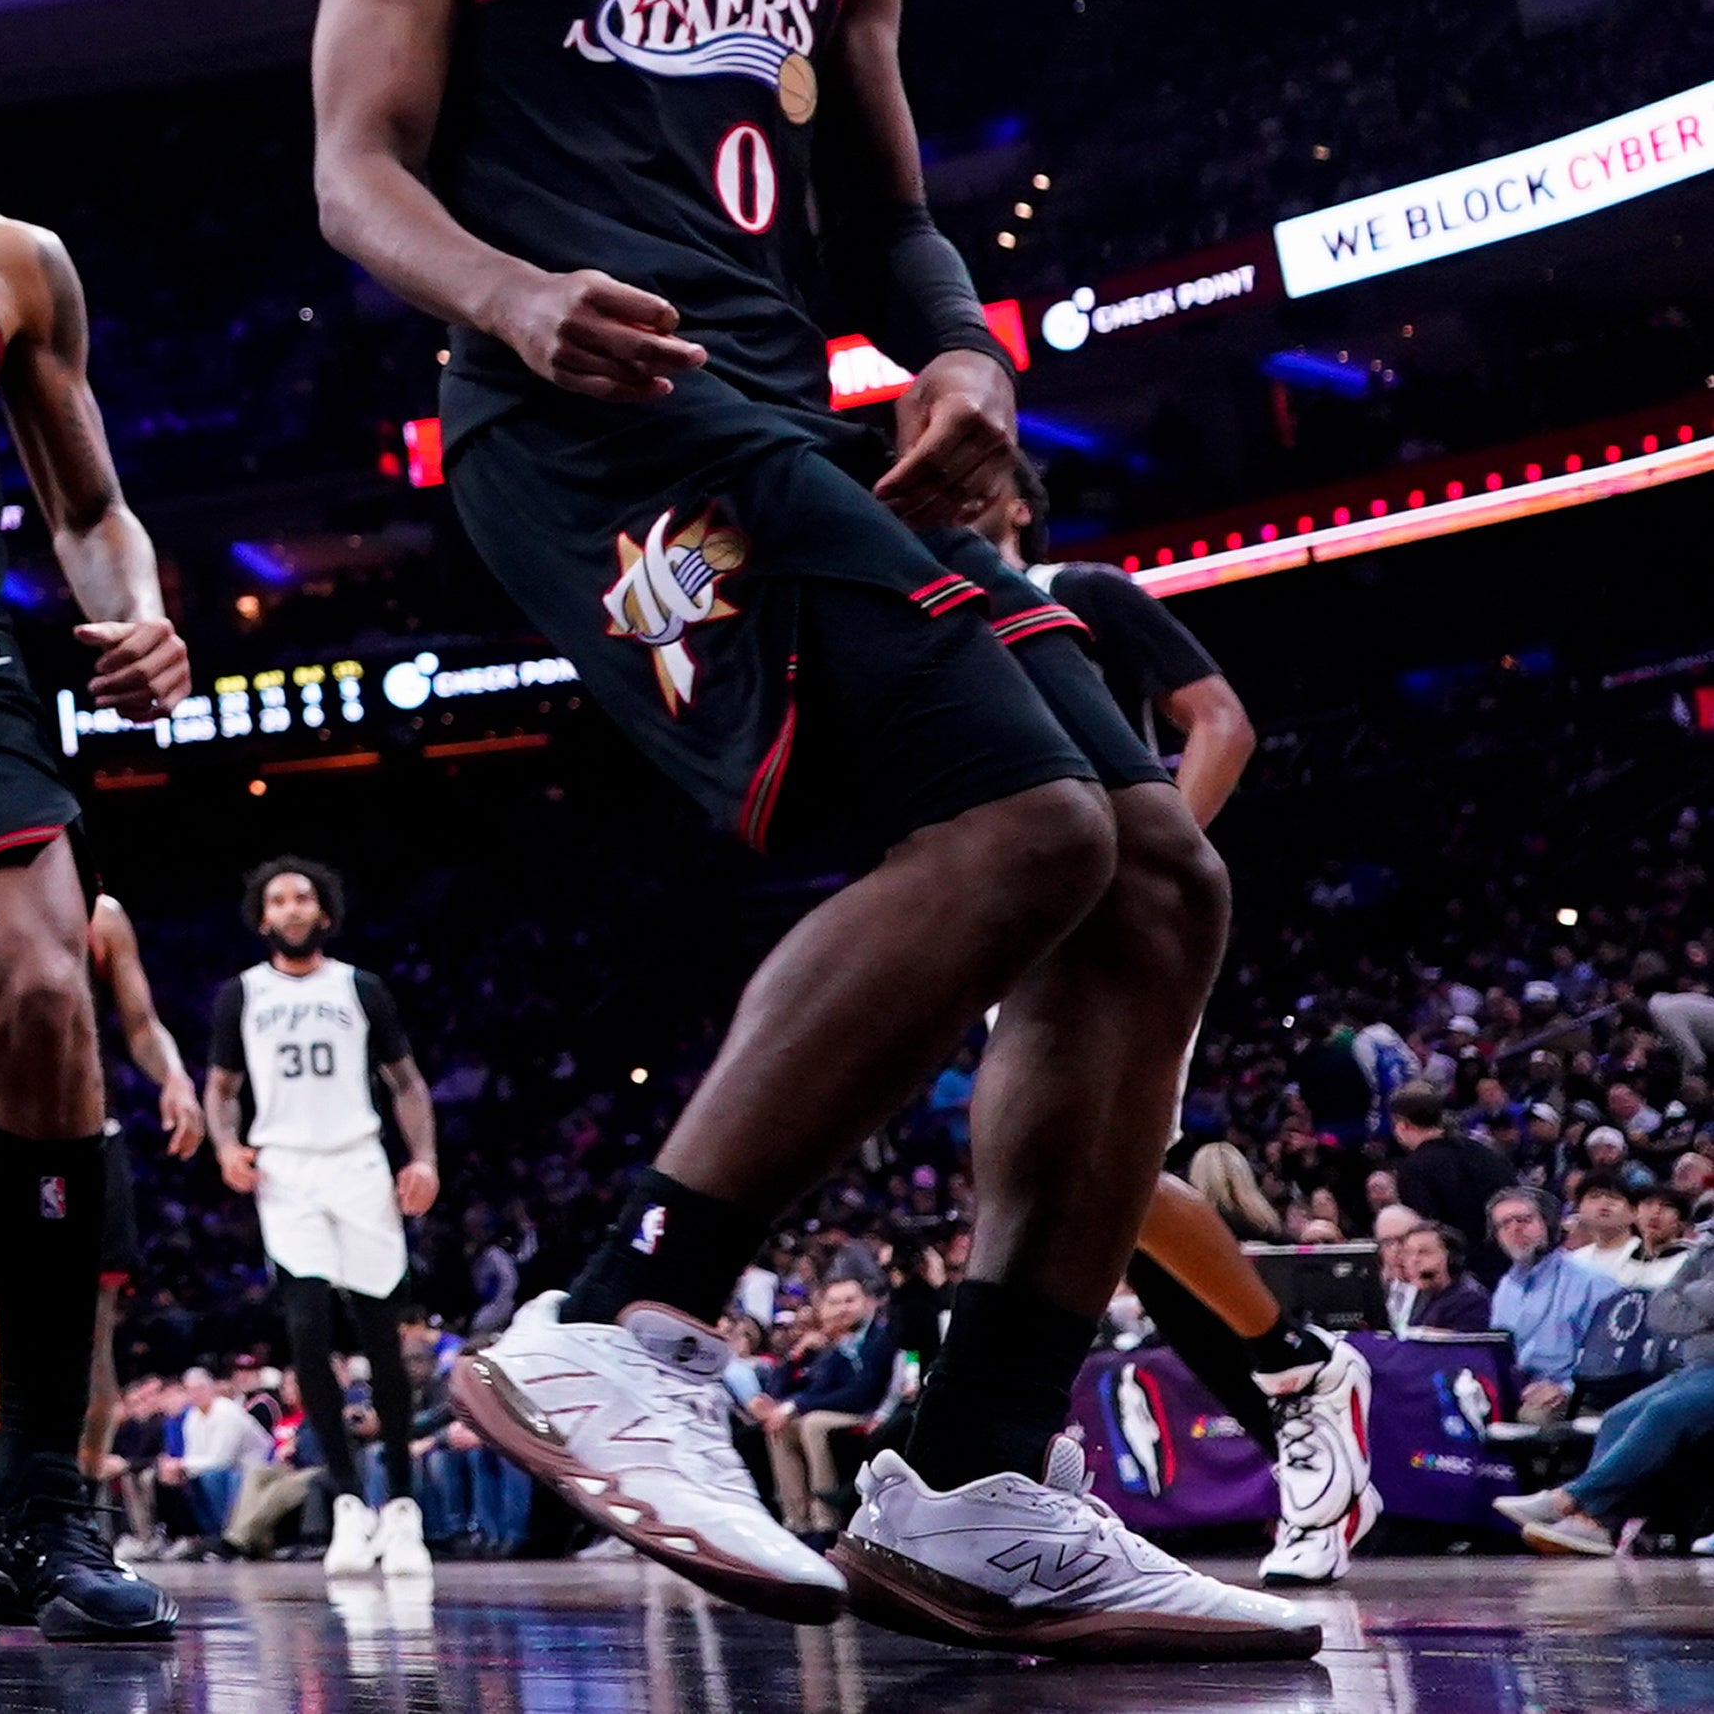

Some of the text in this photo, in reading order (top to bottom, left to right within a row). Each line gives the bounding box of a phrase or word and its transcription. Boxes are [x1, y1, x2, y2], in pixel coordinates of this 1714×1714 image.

[714, 121, 779, 235] 0
[1323, 115, 1704, 261] WE BLOCK CYBER
[1092, 265, 1255, 333] CHECK POINT
[278, 1041, 334, 1078] 30
